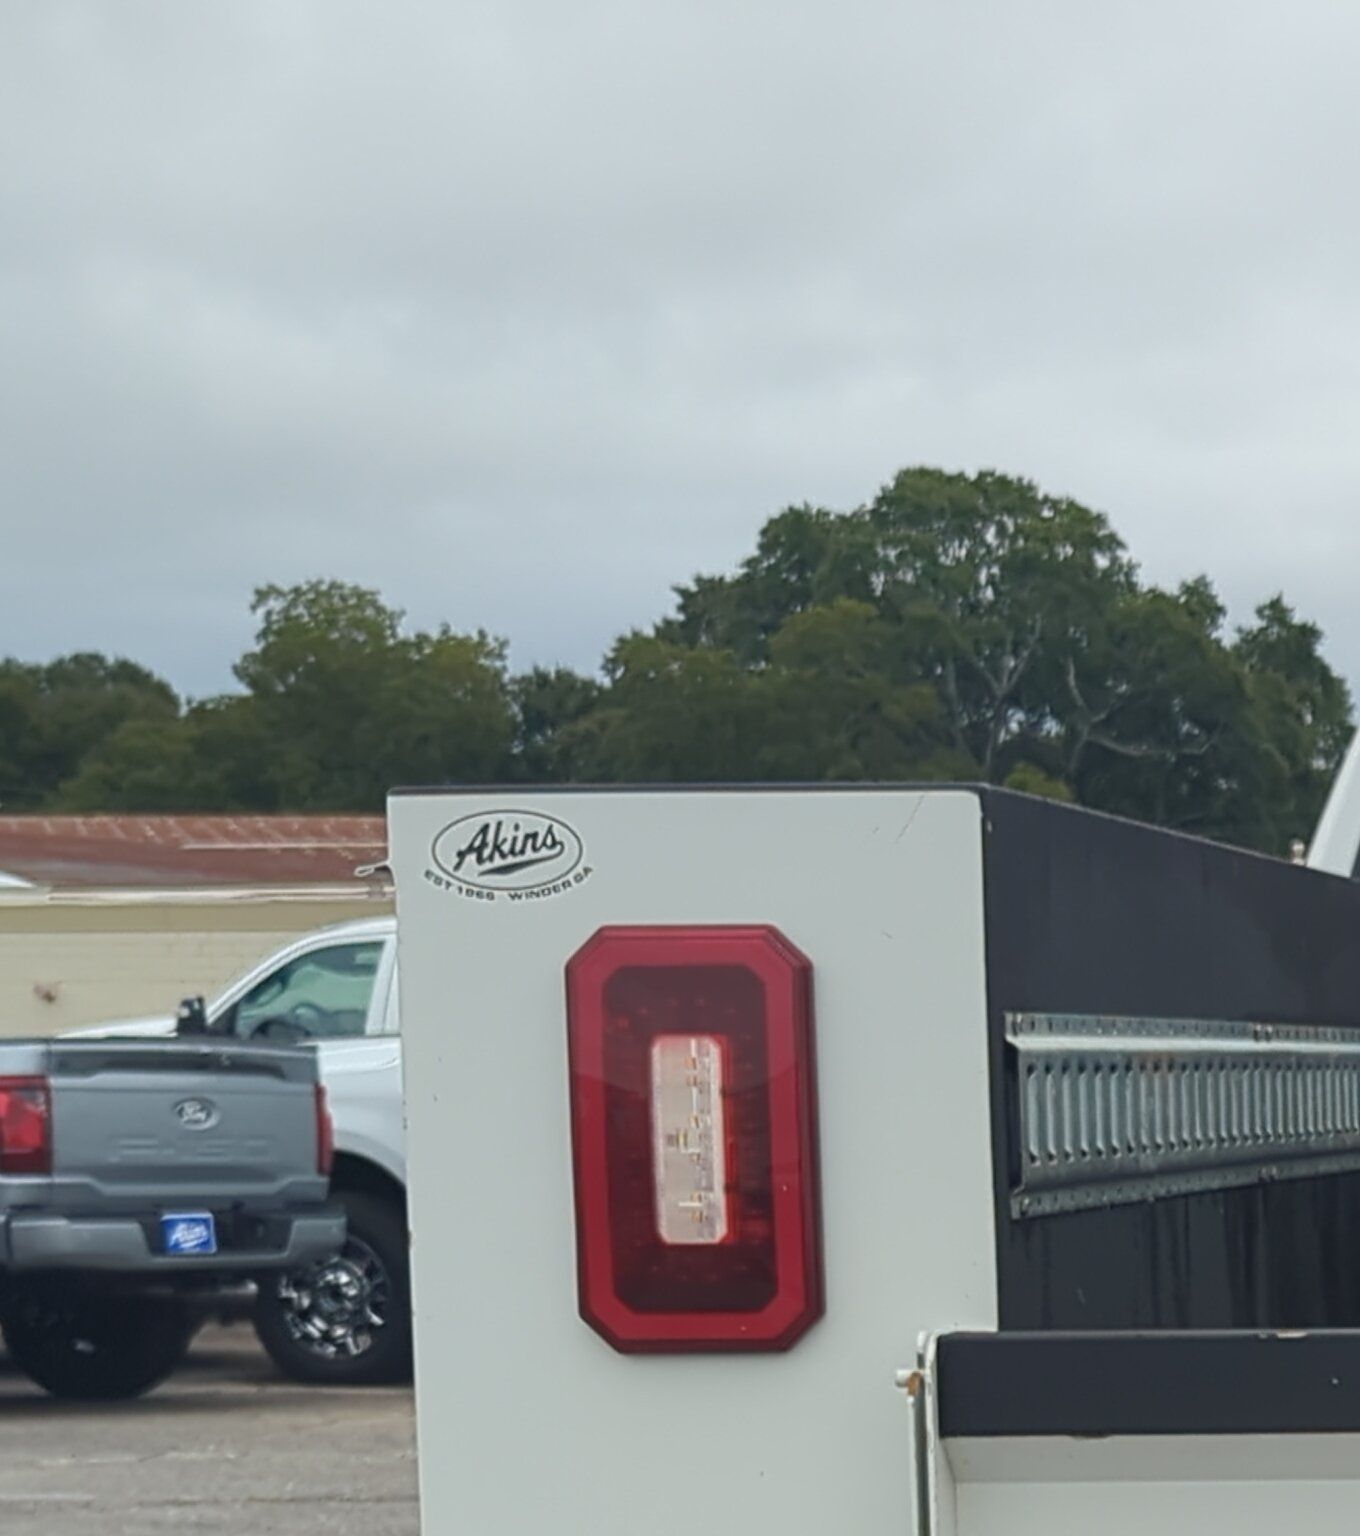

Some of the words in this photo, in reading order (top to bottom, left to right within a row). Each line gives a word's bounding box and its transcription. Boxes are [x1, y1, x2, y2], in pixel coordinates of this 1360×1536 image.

[453, 820, 565, 873] Akins
[424, 869, 453, 890] EST
[508, 881, 572, 900] WINDER
[573, 866, 593, 884] GA
